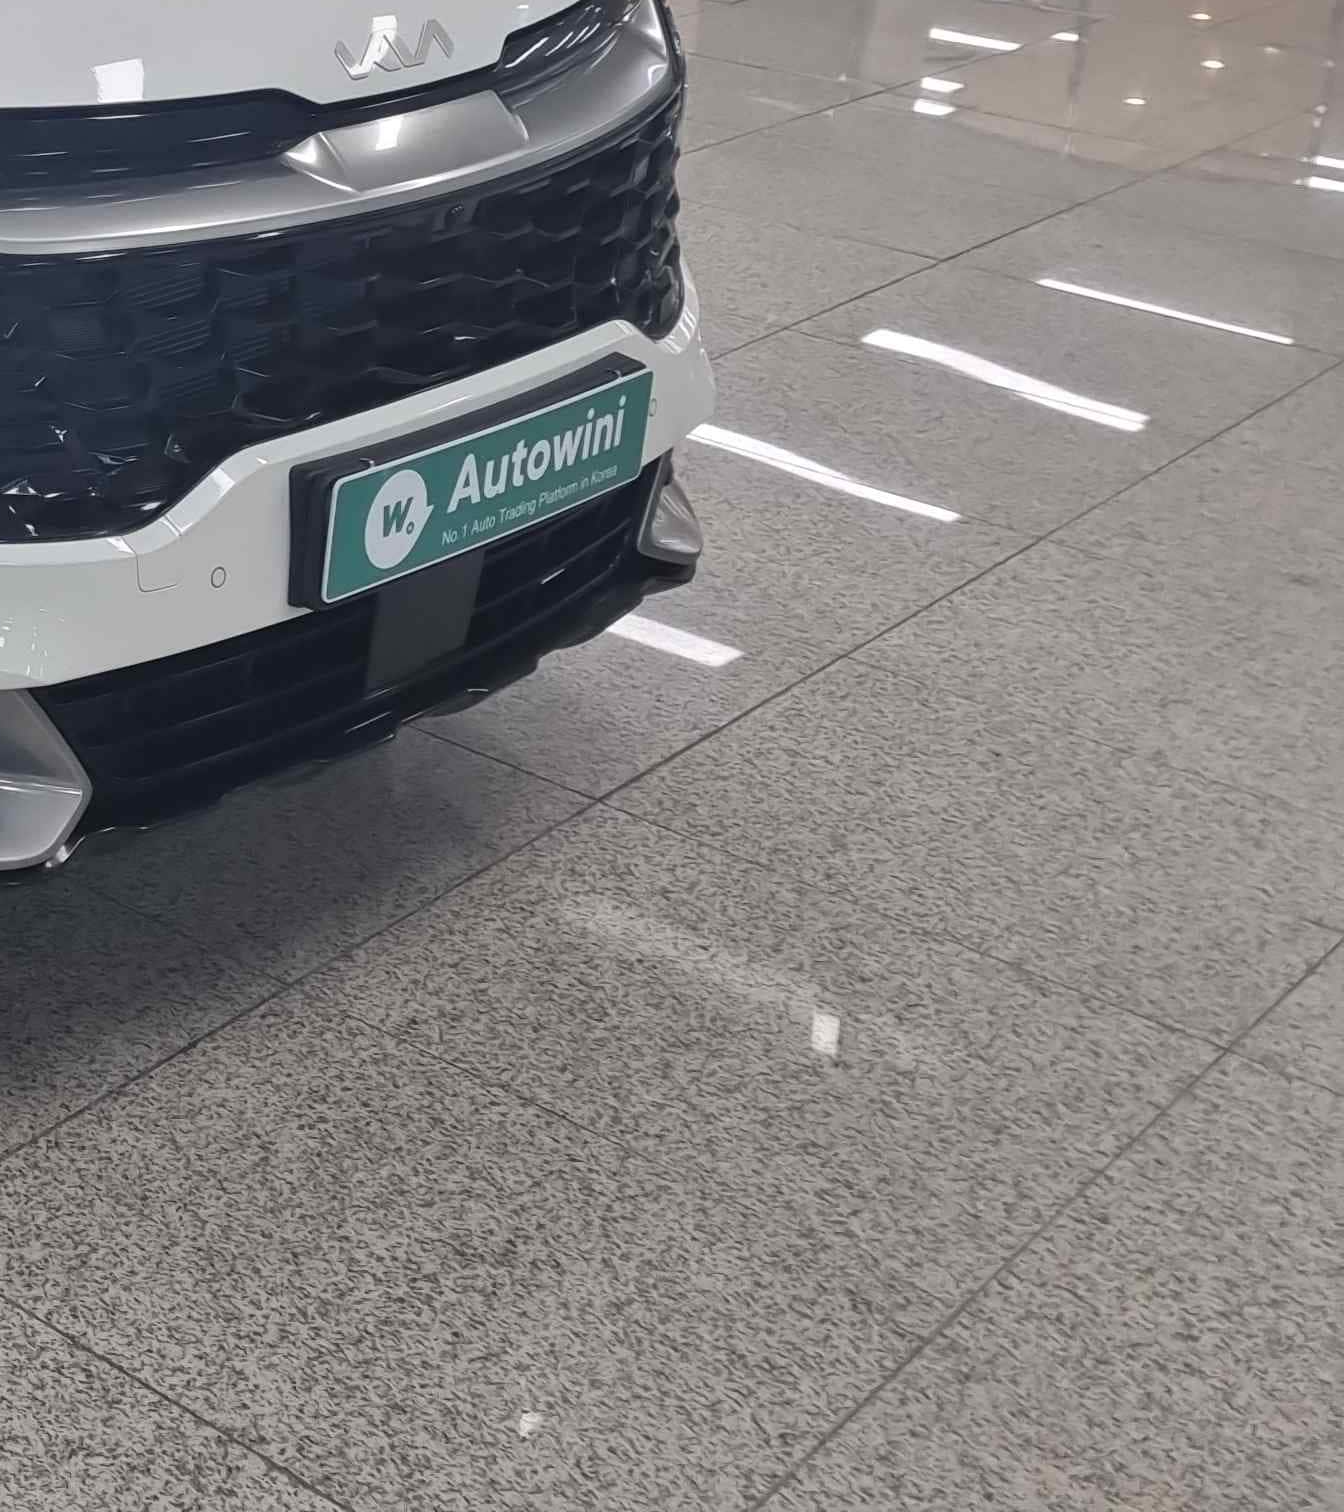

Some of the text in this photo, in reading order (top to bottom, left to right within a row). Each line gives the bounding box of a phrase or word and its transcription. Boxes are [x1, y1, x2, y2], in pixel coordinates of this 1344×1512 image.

[446, 395, 626, 514] Autowini
[471, 516, 496, 535] Auto
[499, 499, 537, 524] Trading
[538, 482, 578, 508] Platform
